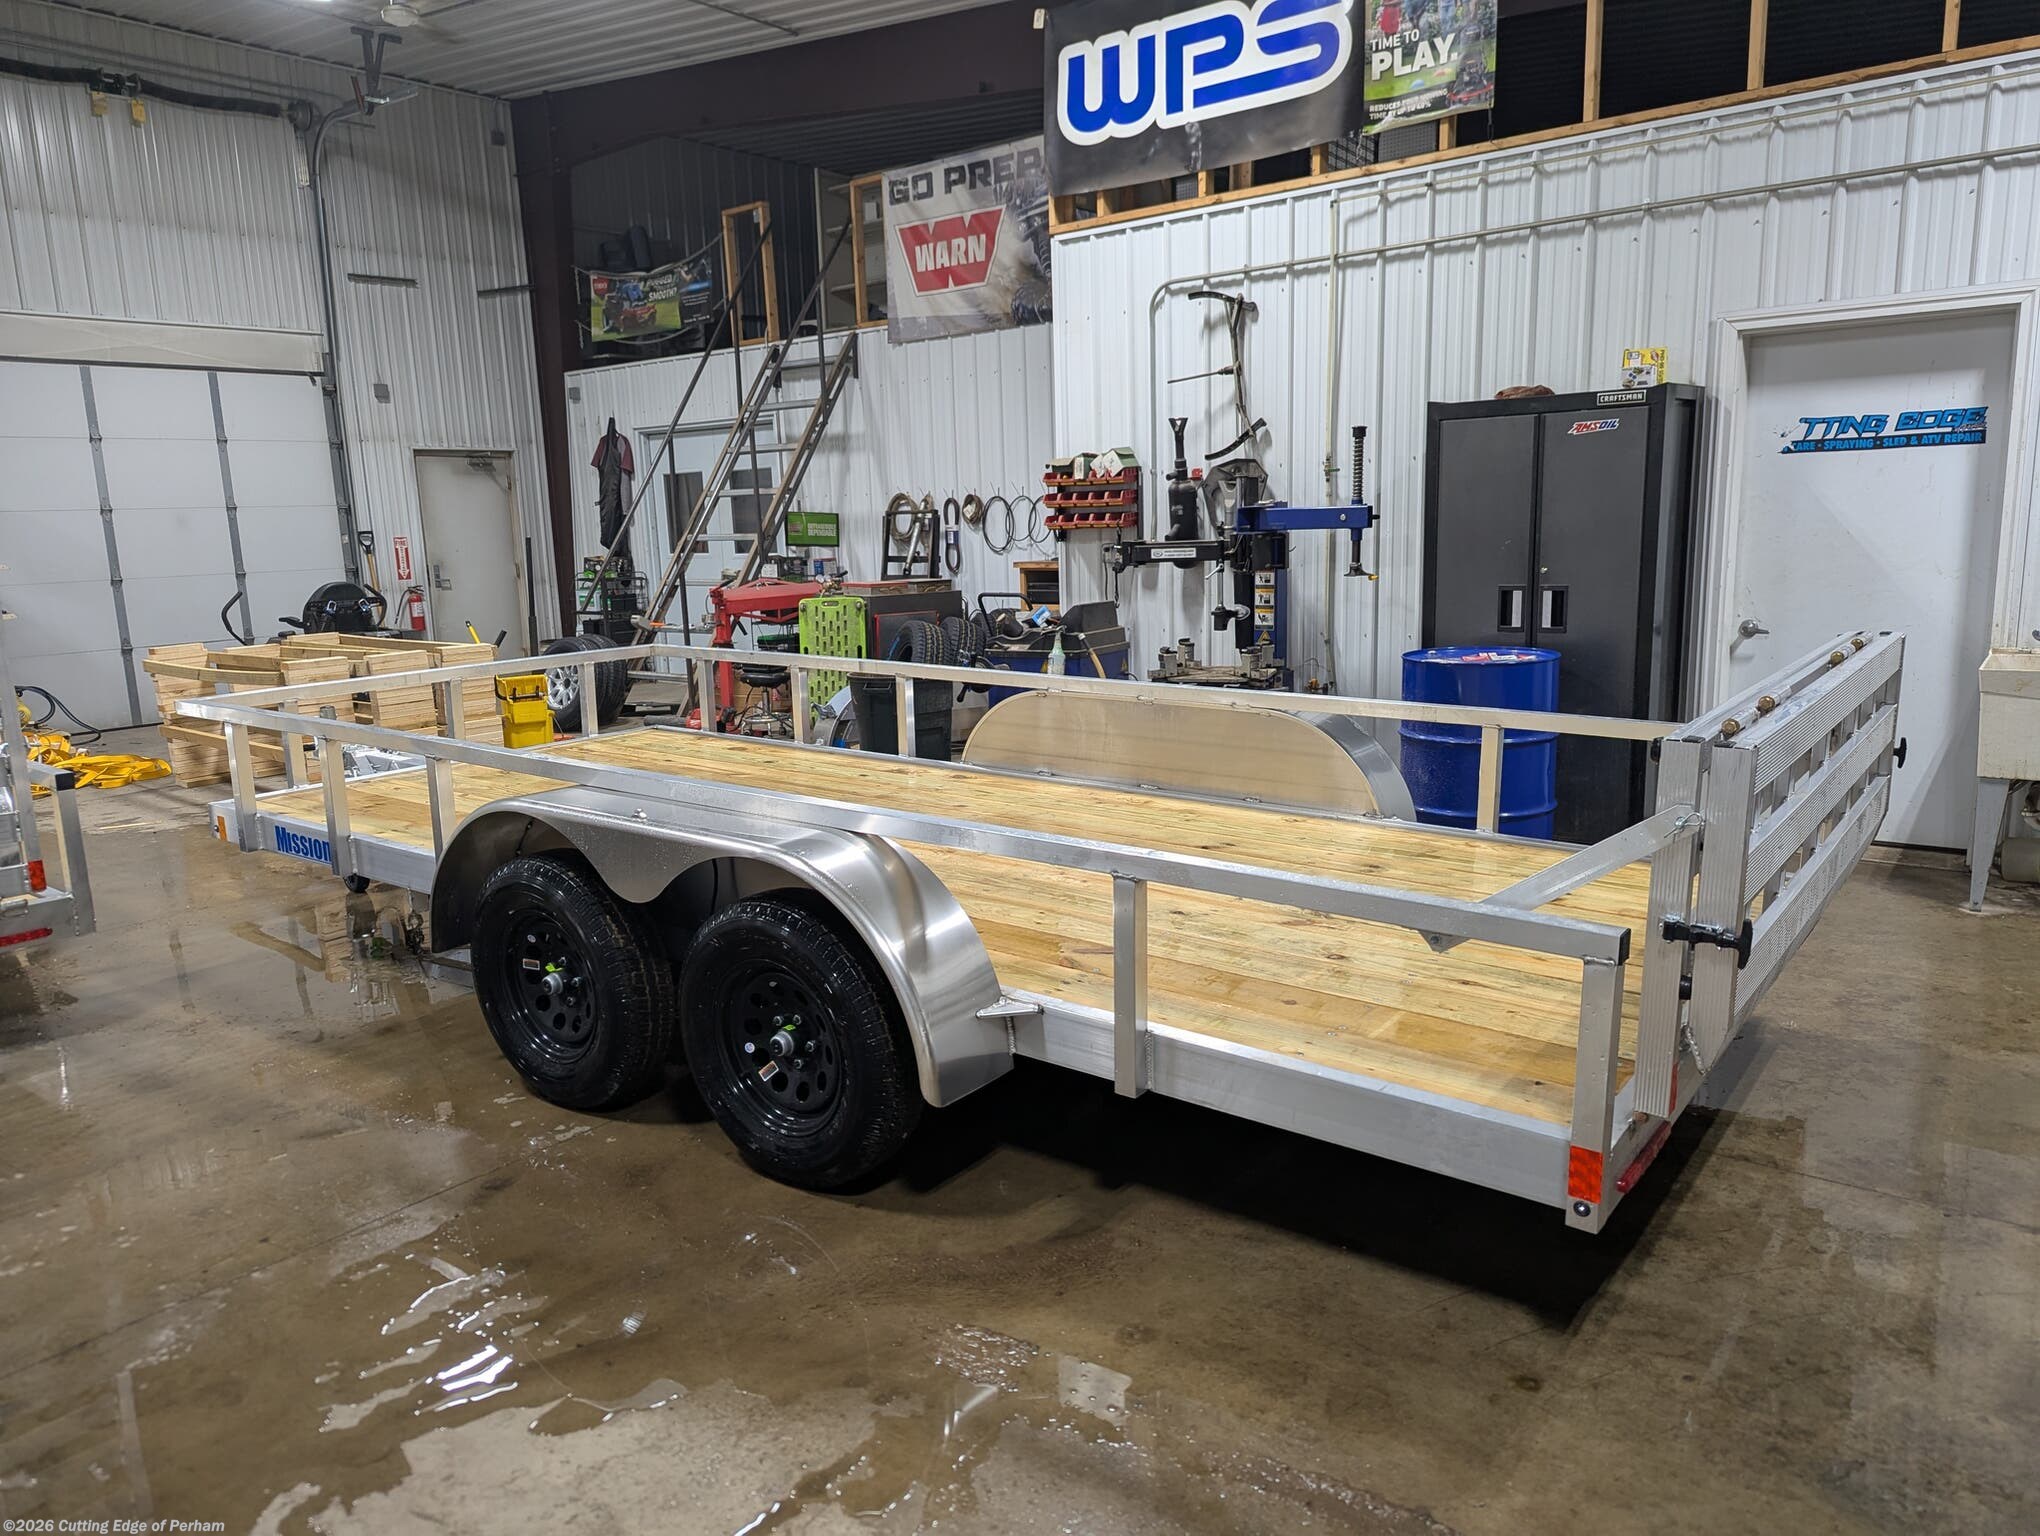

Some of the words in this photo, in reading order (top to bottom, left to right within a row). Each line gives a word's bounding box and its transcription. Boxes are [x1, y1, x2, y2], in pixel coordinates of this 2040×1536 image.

[1370, 34, 1400, 51] TIME
[1402, 28, 1420, 43] TO
[1065, 0, 1342, 134] WPS
[1371, 32, 1458, 81] PLAY.
[1369, 100, 1401, 113] REDUCES
[888, 171, 934, 206] GO
[914, 233, 986, 273] WARN
[1600, 393, 1643, 403] CRAFTSMAN
[1572, 419, 1619, 434] AMSOIL
[1895, 406, 1988, 432] EDGE
[1823, 438, 1874, 450] SPRAYING
[1882, 436, 1907, 447] SLED
[1910, 436, 1918, 446] &
[1921, 434, 1941, 445] ATV
[1944, 432, 1982, 444] REPAIR
